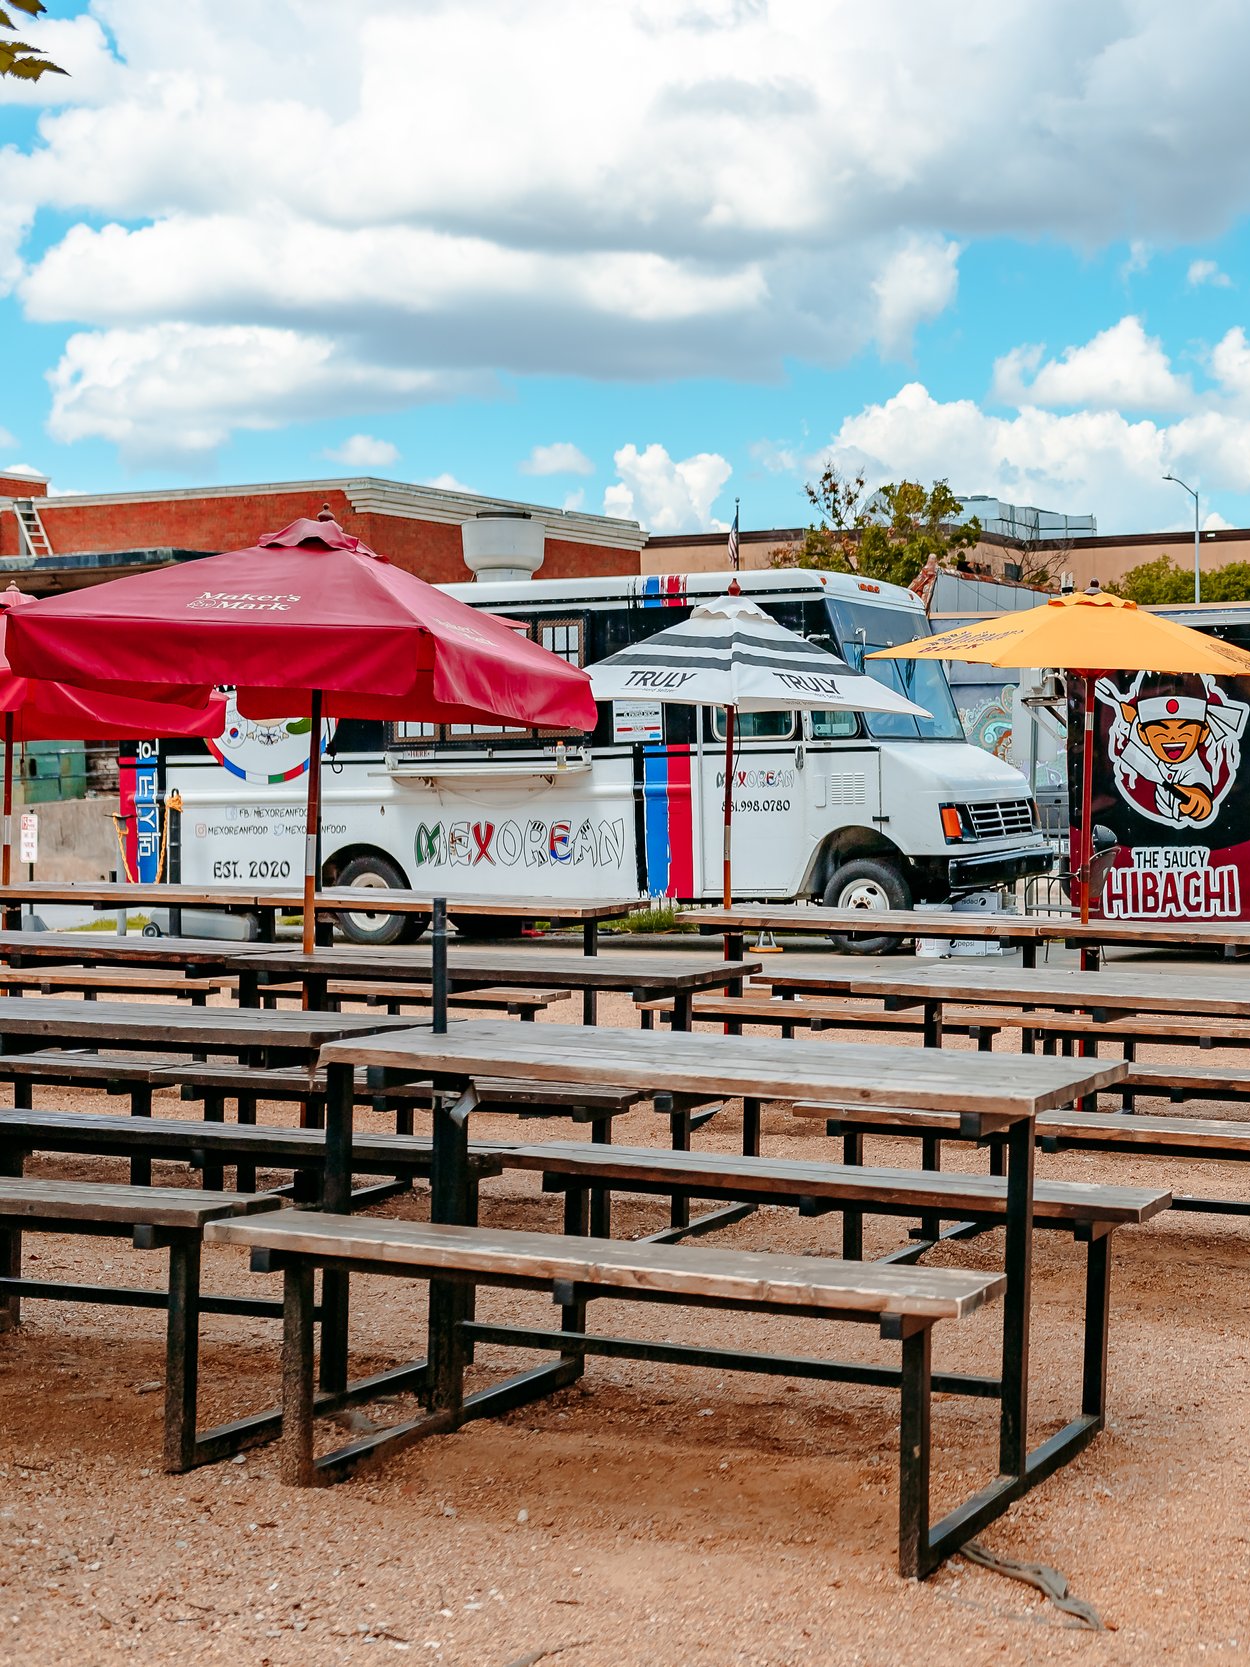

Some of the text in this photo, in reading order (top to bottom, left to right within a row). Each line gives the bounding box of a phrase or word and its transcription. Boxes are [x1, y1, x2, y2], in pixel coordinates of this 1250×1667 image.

[195, 591, 301, 602] Maker's
[215, 600, 291, 611] Mark
[623, 670, 699, 688] TRULY
[771, 671, 841, 695] TRULY
[414, 817, 624, 869] MEXOREAN
[1135, 850, 1208, 869] THE SAUCY
[213, 860, 291, 879] EST. 2020
[1103, 866, 1240, 918] HIBACHI
